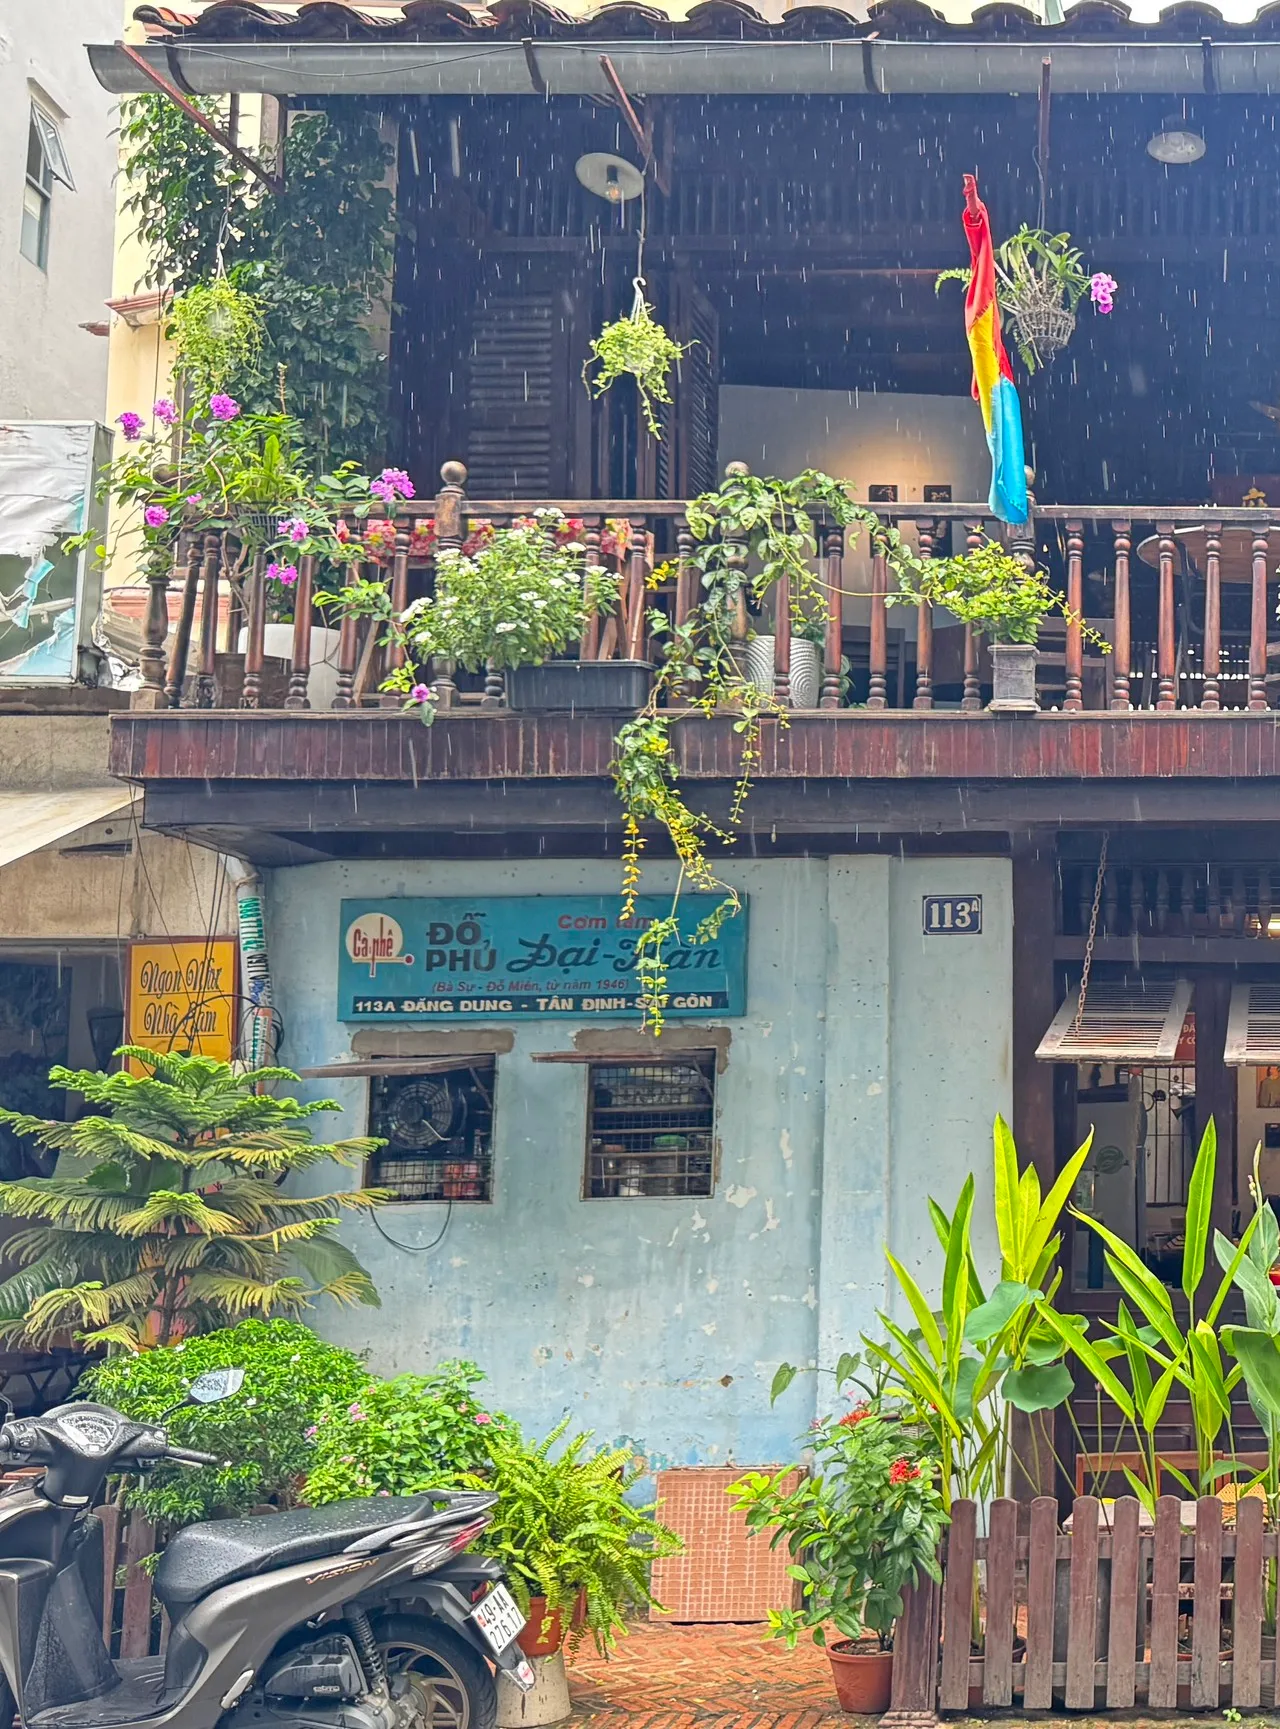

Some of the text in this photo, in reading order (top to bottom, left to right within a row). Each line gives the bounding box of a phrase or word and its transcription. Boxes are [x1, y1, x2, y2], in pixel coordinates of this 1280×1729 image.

[558, 914, 607, 929] Cơm
[425, 939, 497, 972] PHỦ
[141, 960, 182, 999] Ngon
[597, 979, 629, 991] 1946)
[144, 1001, 180, 1035] Nhà
[355, 1001, 396, 1013] 113A
[401, 998, 454, 1014] ĐẶNG
[460, 1000, 513, 1012] DUNG
[536, 995, 574, 1011] TÂN
[673, 993, 713, 1009] GÒN
[480, 1590, 510, 1626] 49-AA
[489, 1606, 522, 1649] 276.17
